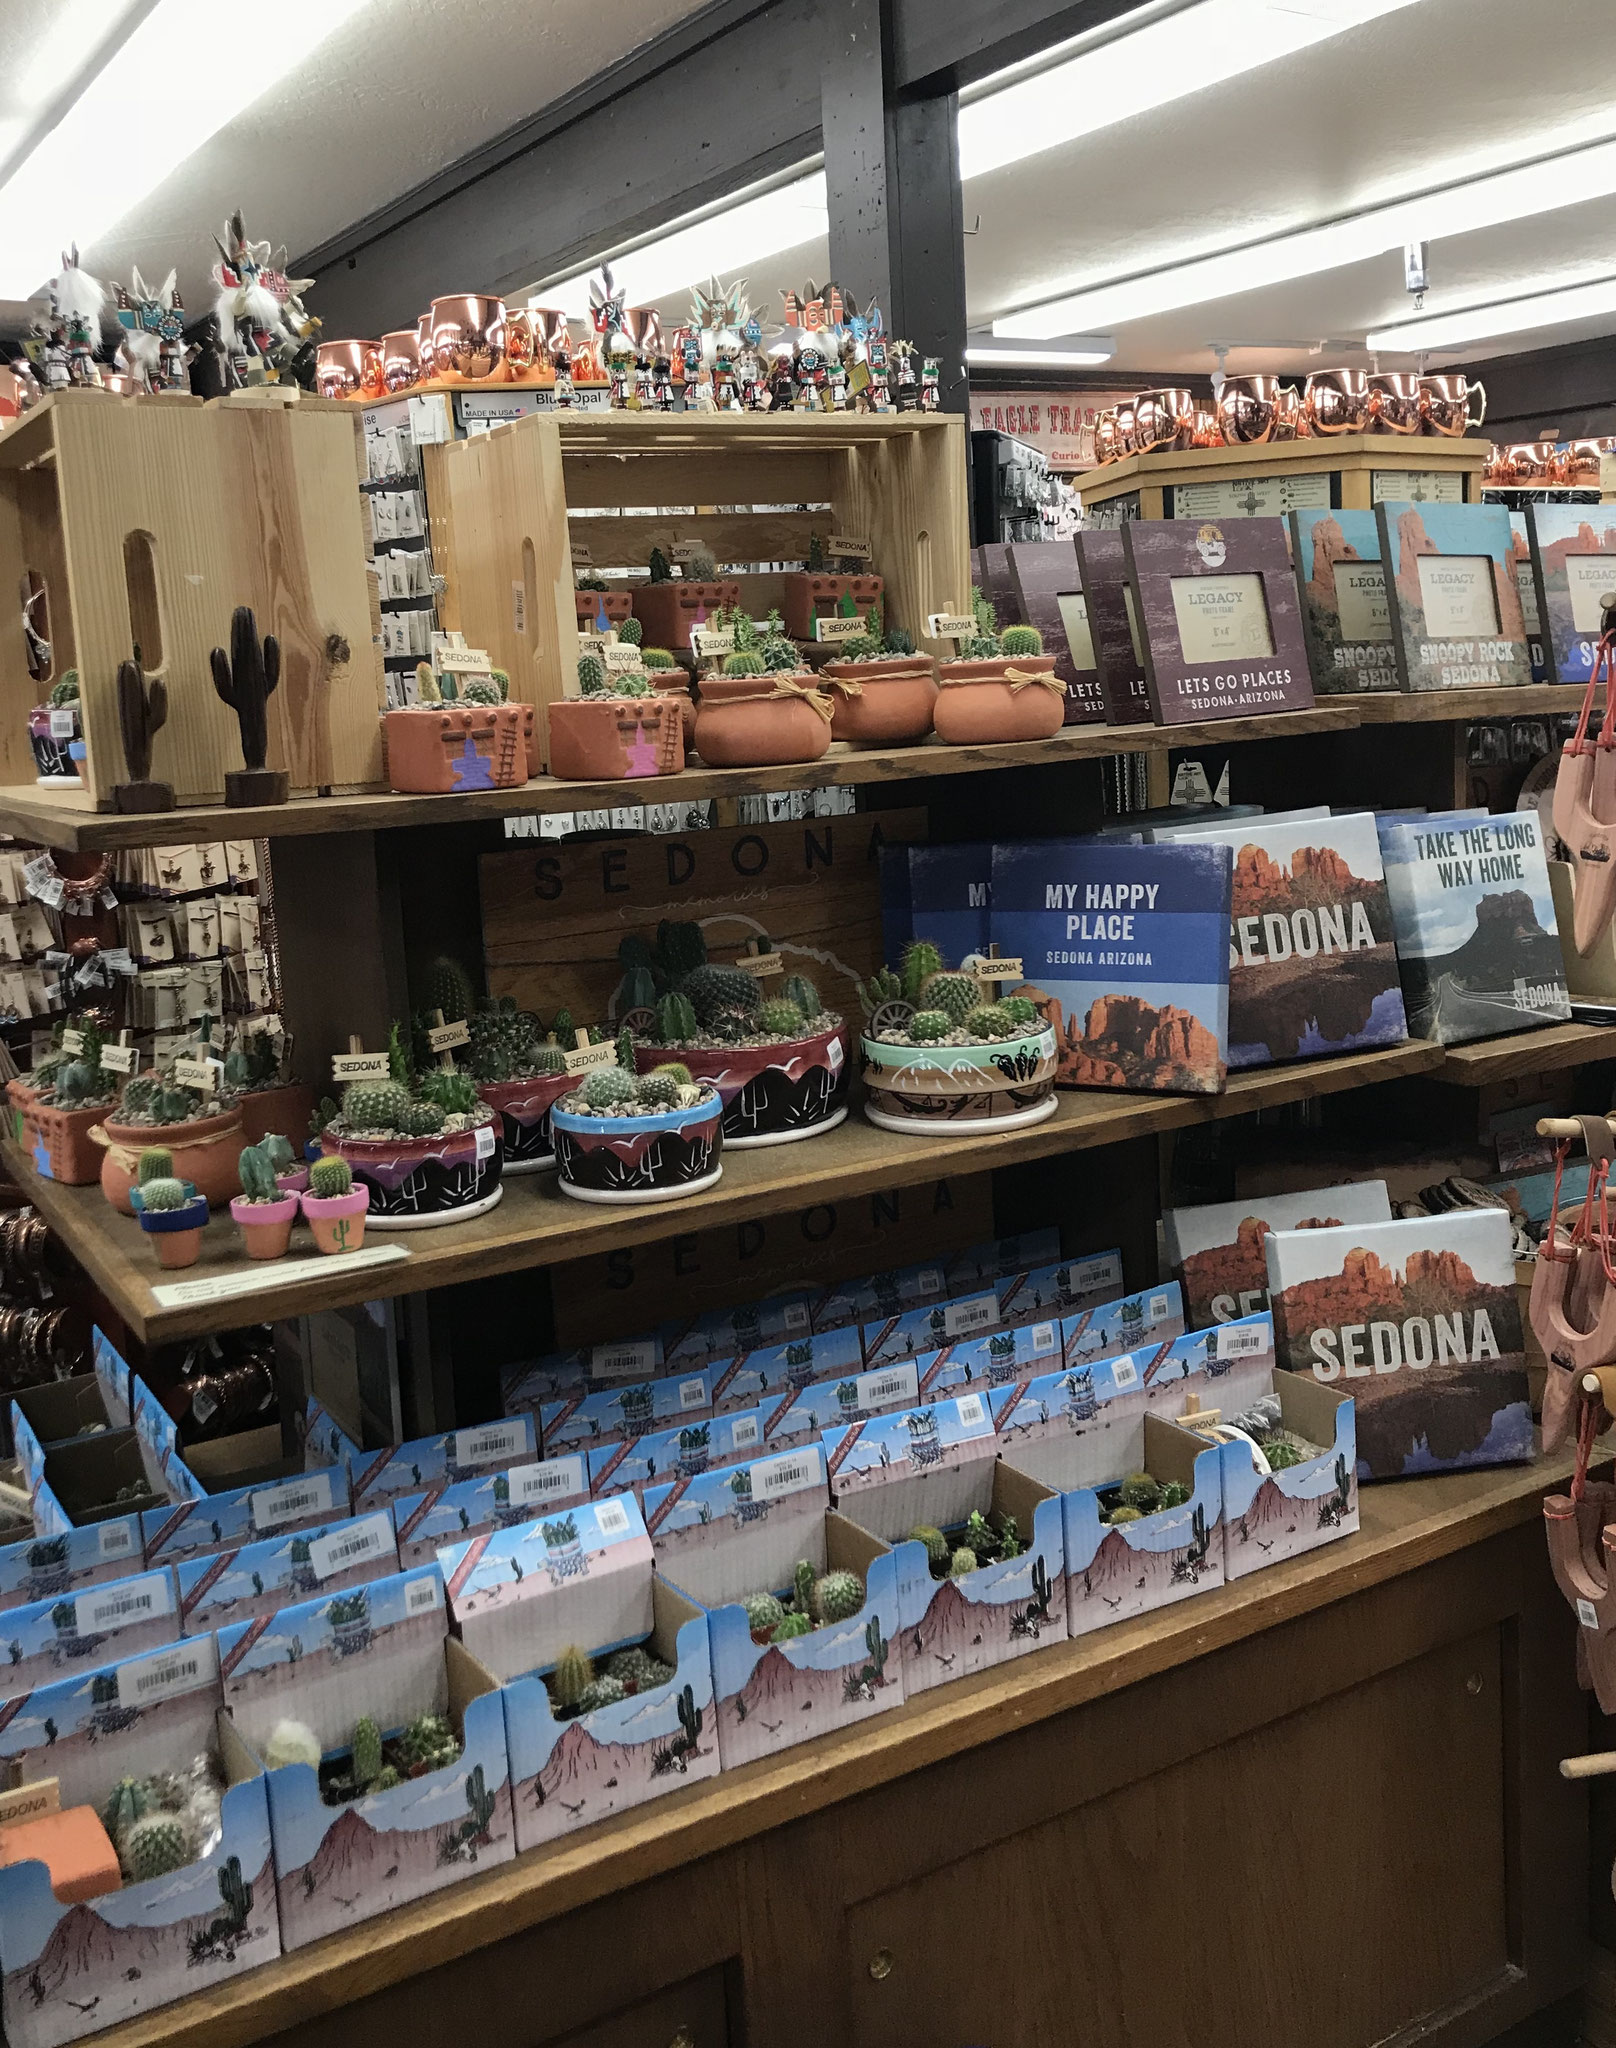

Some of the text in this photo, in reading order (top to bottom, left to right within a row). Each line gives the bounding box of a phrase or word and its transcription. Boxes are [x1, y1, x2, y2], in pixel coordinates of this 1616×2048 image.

[465, 410, 488, 418] MADE
[981, 405, 1041, 434] EAGLE
[1051, 450, 1080, 460] Curio
[835, 541, 867, 551] SEDONA
[1430, 573, 1475, 585] LEGACY
[1187, 591, 1243, 605] LEGACY
[828, 622, 862, 633] SEDONA
[943, 620, 972, 632] SEDONA
[444, 650, 483, 665] SEDONA
[609, 651, 639, 662] SEDONA
[1420, 641, 1515, 665] SNOOPY ROCK
[1177, 668, 1292, 695] LETS GO PLACES
[1441, 665, 1501, 685] SEDONA
[1069, 682, 1102, 698] LETS
[1414, 823, 1536, 860] TAKE THE LONG
[1437, 854, 1524, 888] WAY HOME
[1045, 884, 1159, 910] MY HAPPY
[1066, 915, 1135, 941] PLACE
[1046, 951, 1152, 966] SEDONA ARIZONA
[981, 962, 1017, 975] SEDONA
[1513, 982, 1562, 1012] SEDONA
[434, 1028, 464, 1046] SEDONA
[340, 1059, 382, 1074] SEDONA
[569, 1050, 609, 1069] SEDONA
[1310, 1307, 1501, 1382] SEDONA
